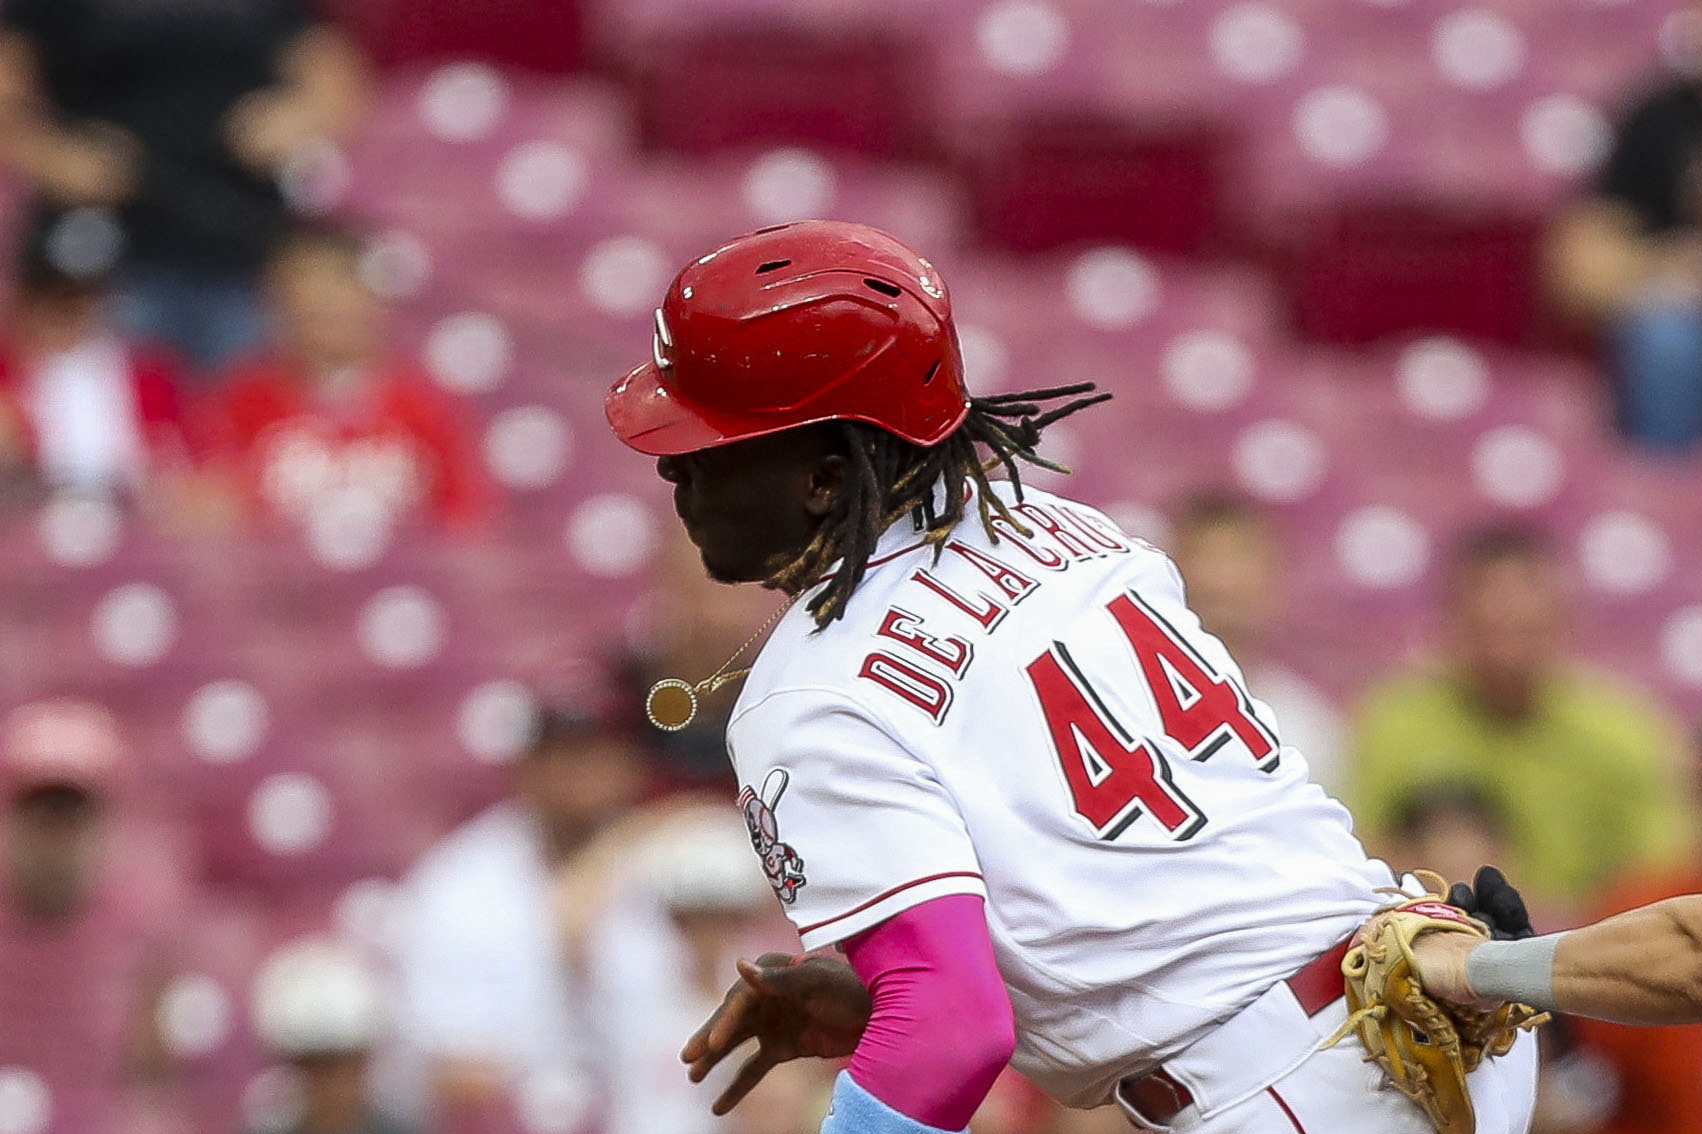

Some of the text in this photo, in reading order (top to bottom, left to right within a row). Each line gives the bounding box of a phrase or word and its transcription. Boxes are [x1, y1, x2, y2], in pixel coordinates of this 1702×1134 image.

[910, 538, 1042, 635] LA
[857, 604, 974, 727] DE
[1025, 588, 1281, 842] 44
